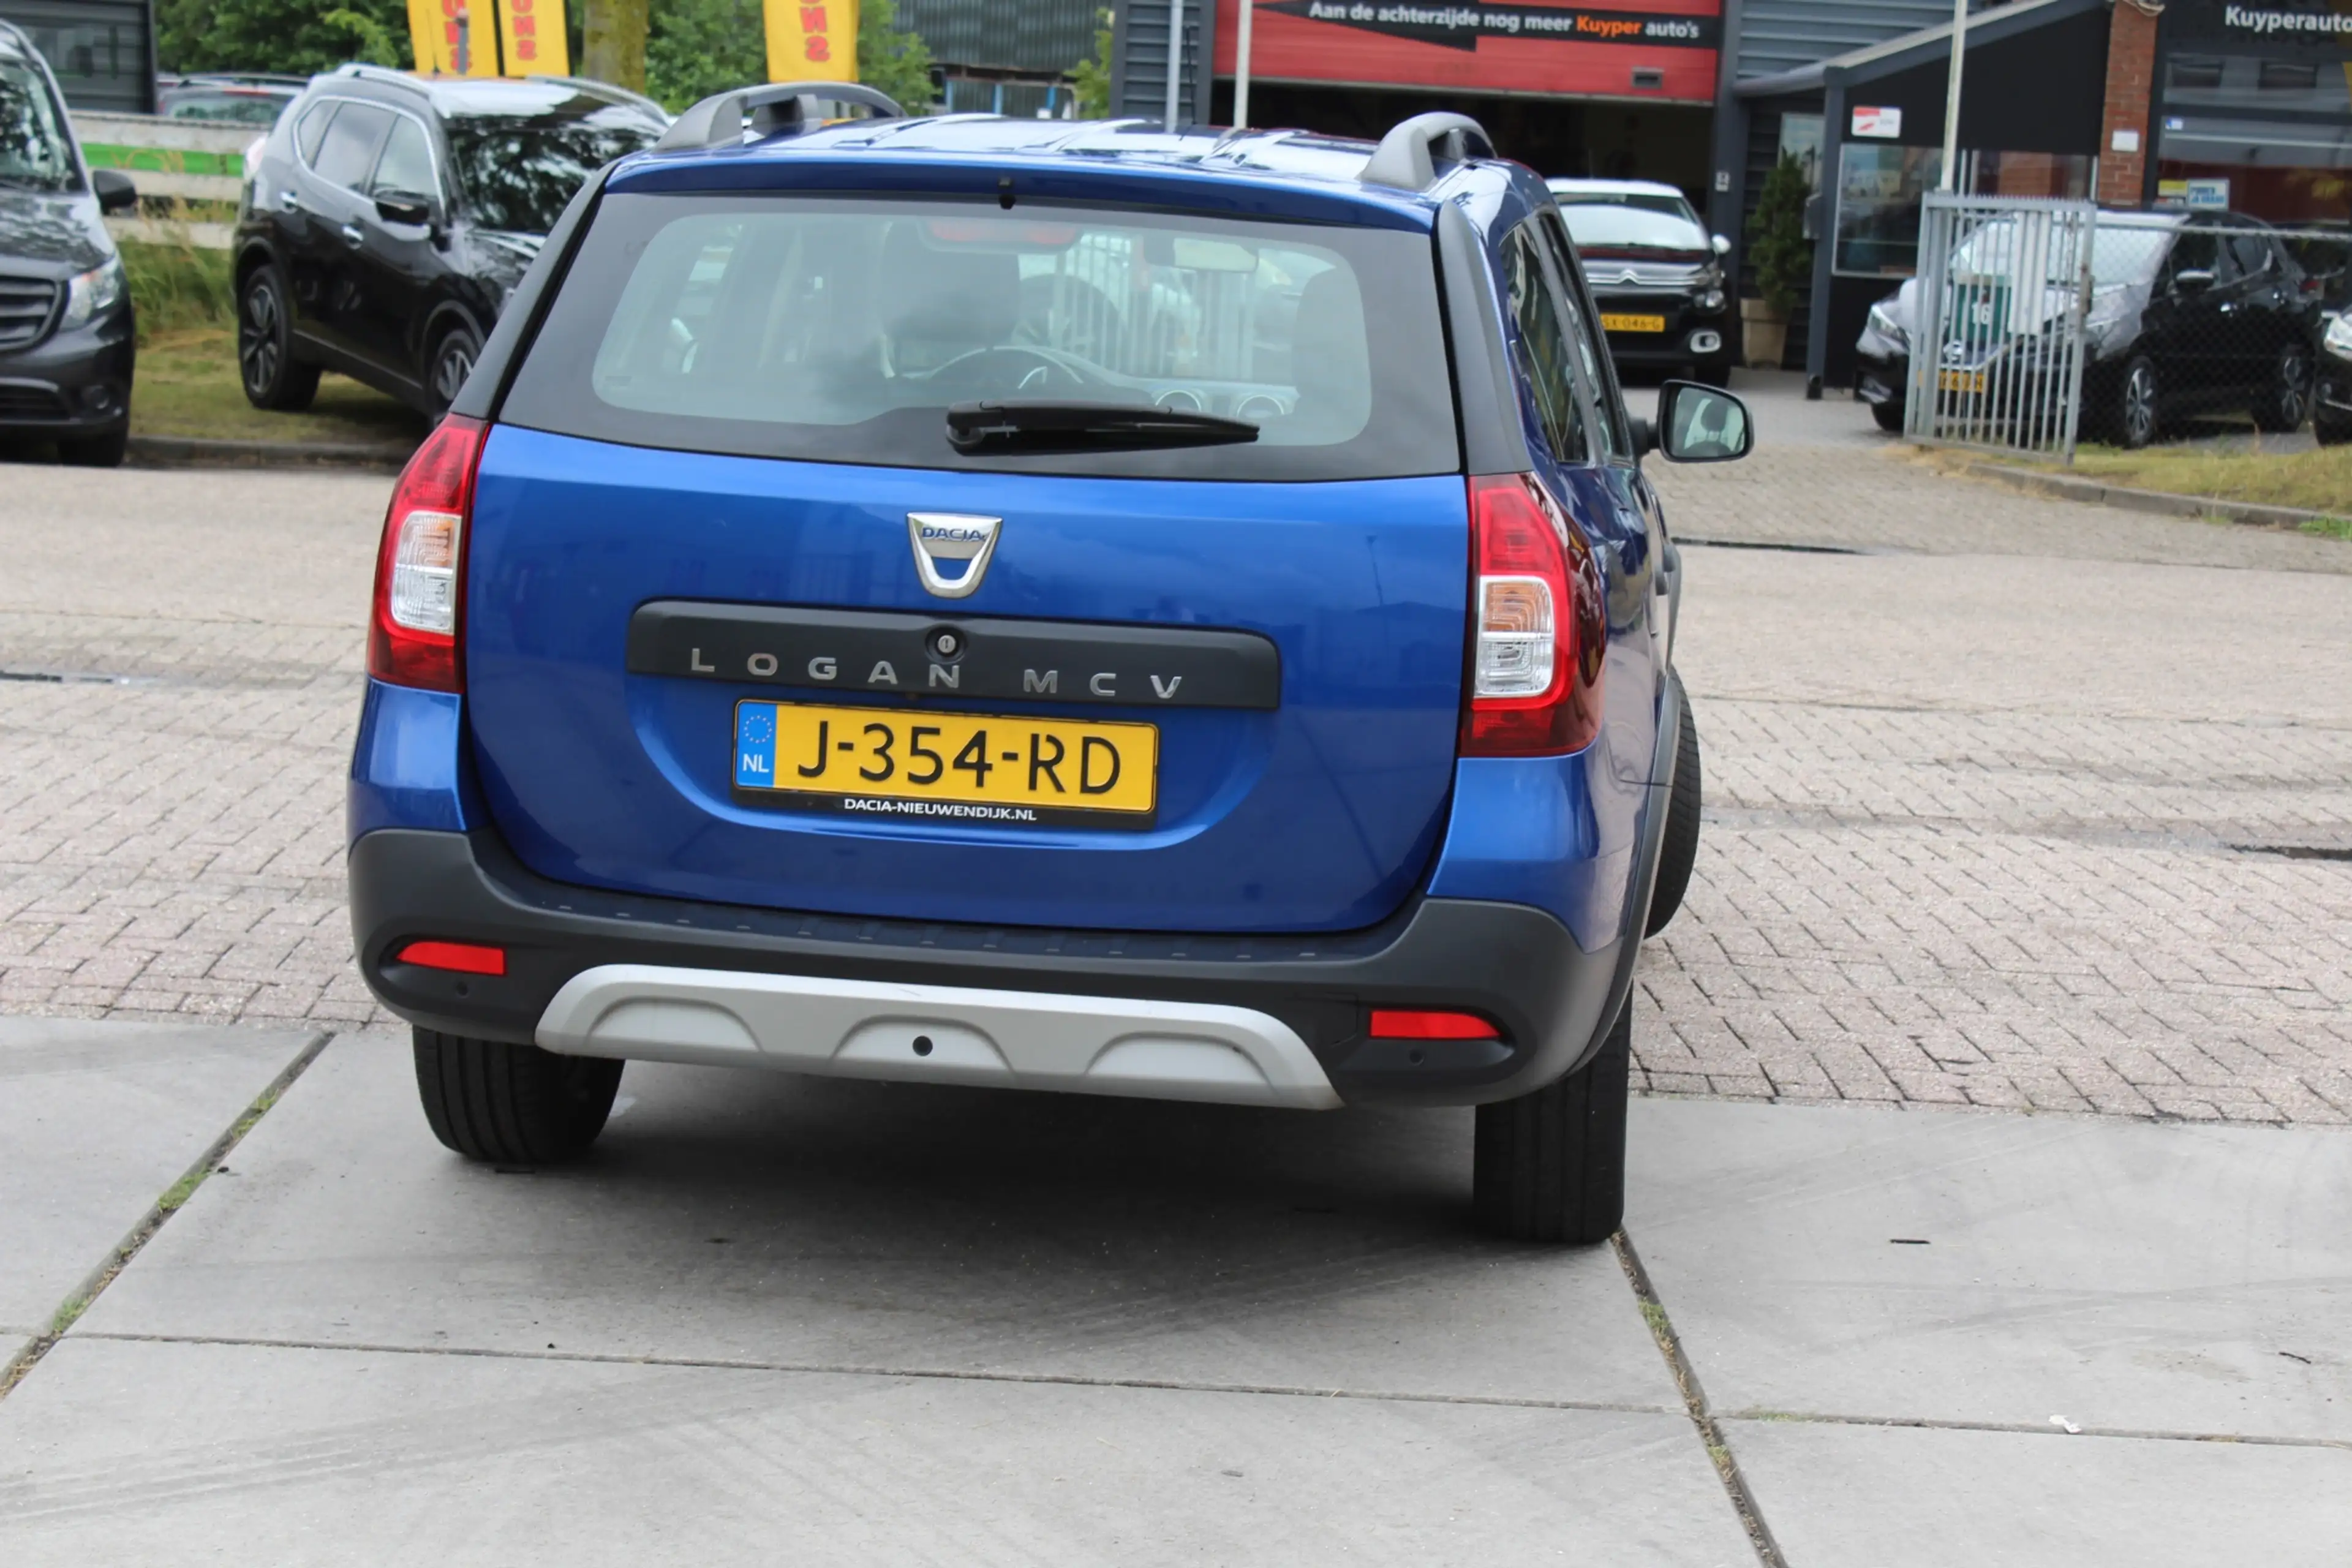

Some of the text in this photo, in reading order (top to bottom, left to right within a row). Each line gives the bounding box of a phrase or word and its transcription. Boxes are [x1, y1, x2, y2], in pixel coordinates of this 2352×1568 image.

[1309, 2, 1700, 38] Aan de achterzijde nog meer Kuyper auto's
[921, 527, 984, 541] DACIA
[690, 647, 1183, 699] LOGAN MCV
[742, 753, 769, 773] NL
[797, 720, 1121, 795] J-354-RD
[843, 798, 1038, 821] DACIA-NIEUWENDIJK.NL
